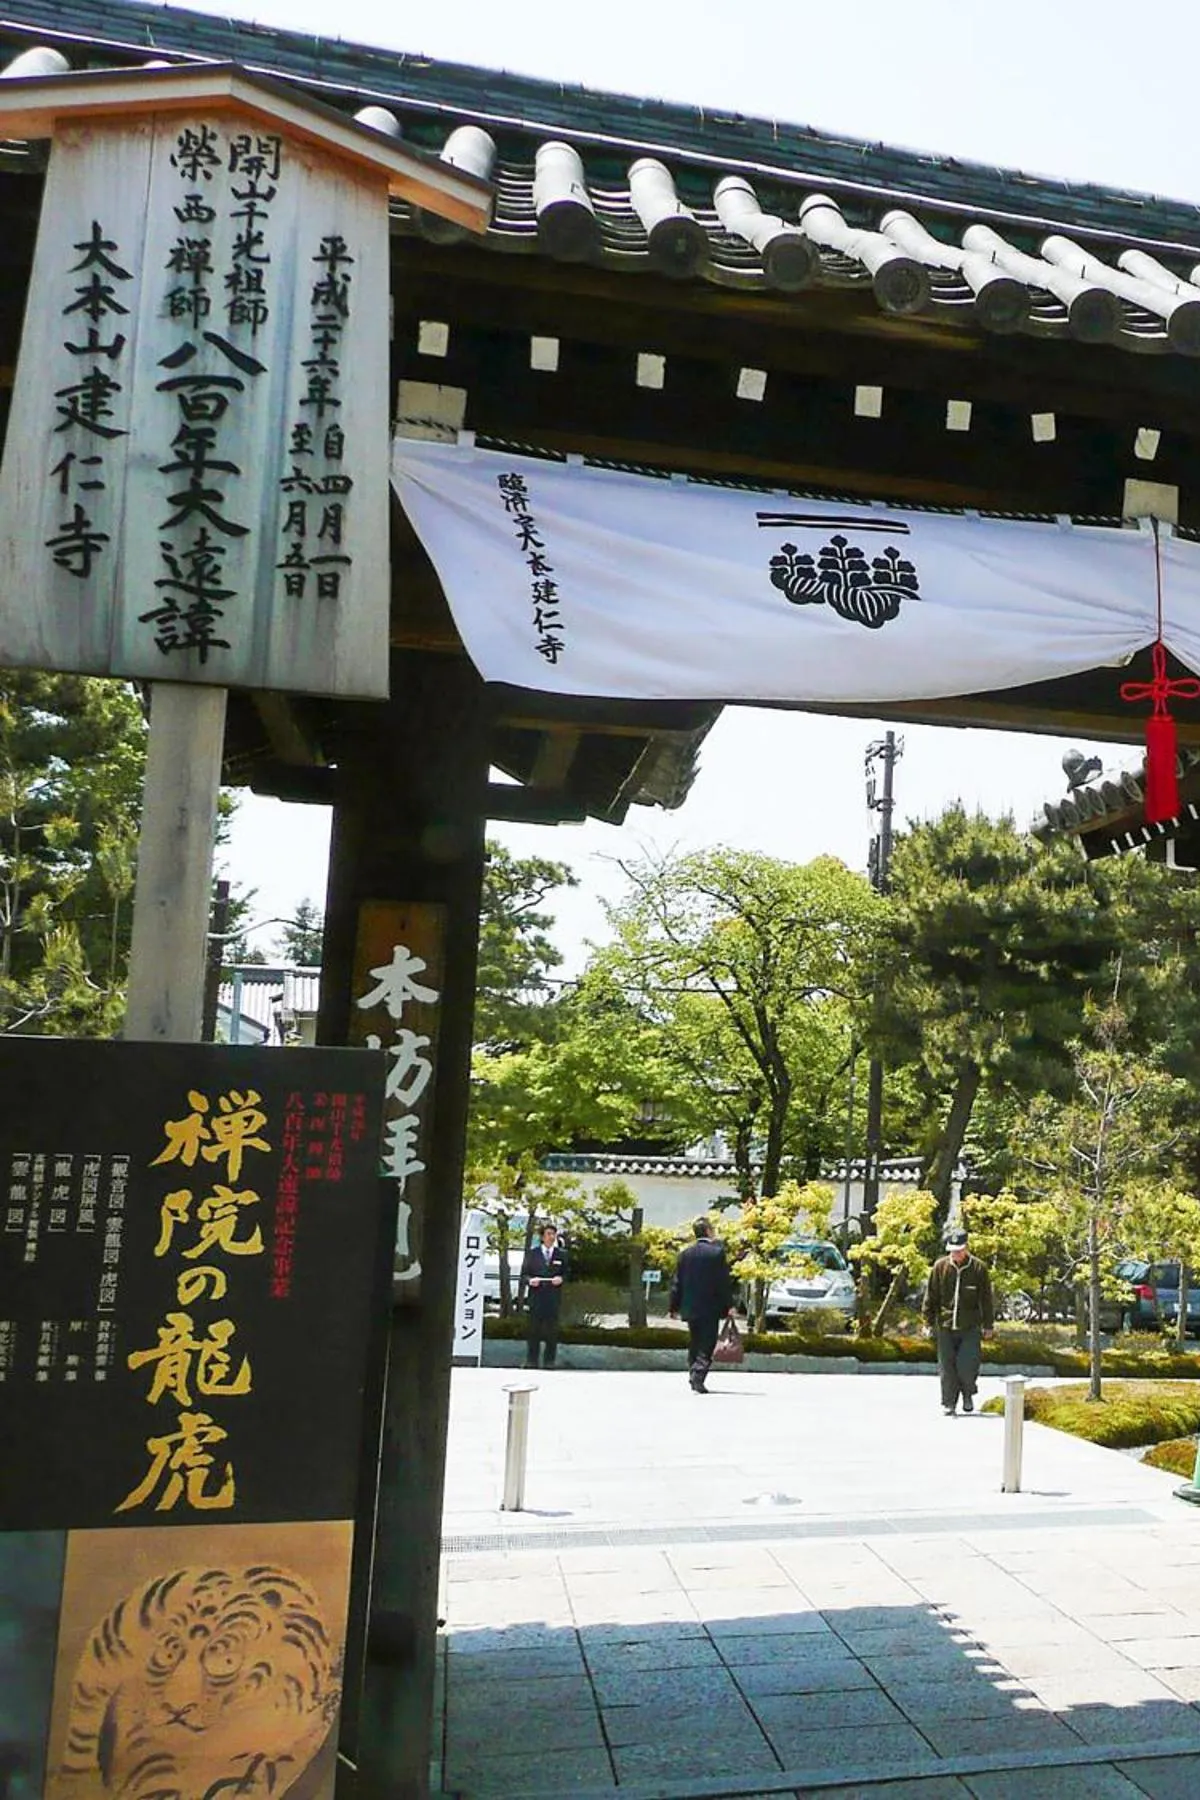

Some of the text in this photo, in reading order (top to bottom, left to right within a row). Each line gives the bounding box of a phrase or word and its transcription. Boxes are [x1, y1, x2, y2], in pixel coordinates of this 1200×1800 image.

[224, 134, 282, 336] 開山千光祖師
[299, 235, 355, 414] 平成二十六年
[45, 221, 134, 579] 大本山建仁寺
[138, 331, 269, 664] 八百年大遠諱
[276, 422, 315, 599] 至六月五日
[312, 424, 354, 600] 自四月一日
[113, 1089, 271, 1514] 禅院の龍虎
[462, 1236, 480, 1340] ロケーション
